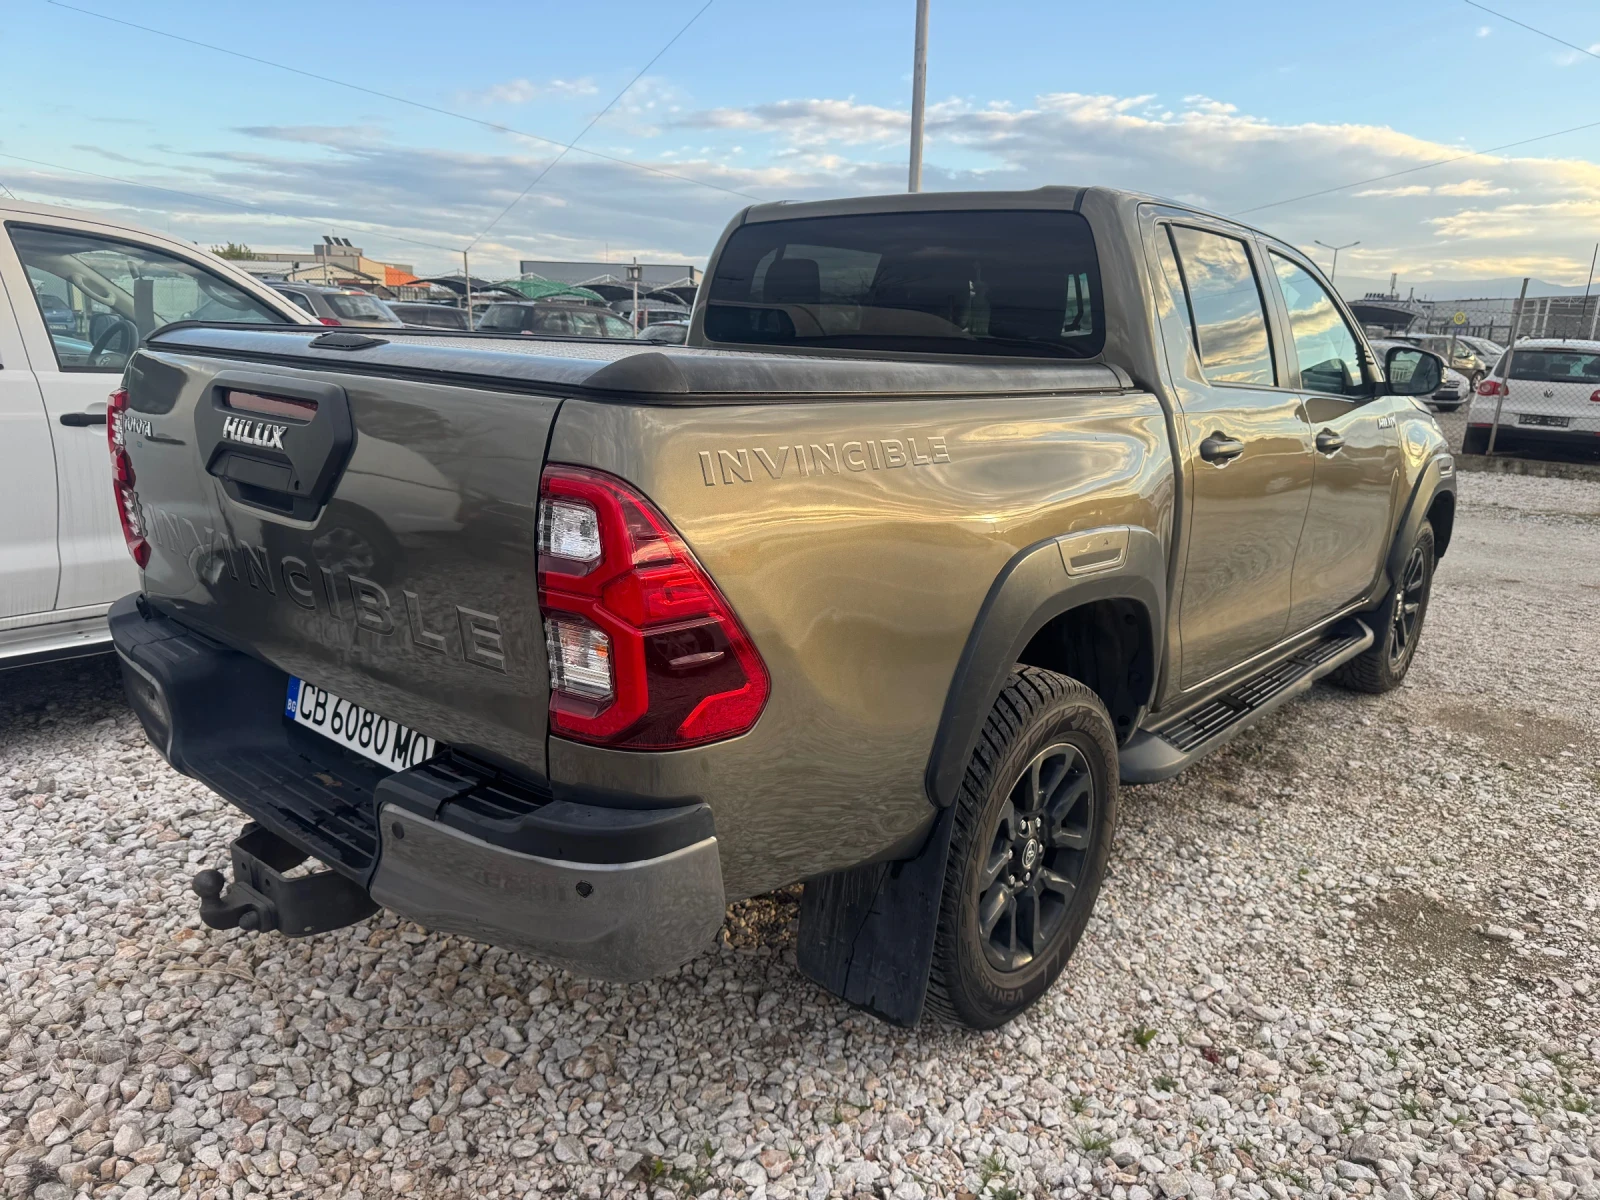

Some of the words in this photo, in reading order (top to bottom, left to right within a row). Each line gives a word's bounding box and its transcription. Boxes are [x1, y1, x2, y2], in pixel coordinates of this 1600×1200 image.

[222, 416, 288, 450] HILUX
[699, 436, 951, 486] INVINCIBLE
[147, 502, 508, 675] INVINCIBLE
[287, 698, 297, 713] BG
[300, 682, 328, 726] CB
[331, 698, 389, 755] 6080
[391, 723, 427, 768] MO
